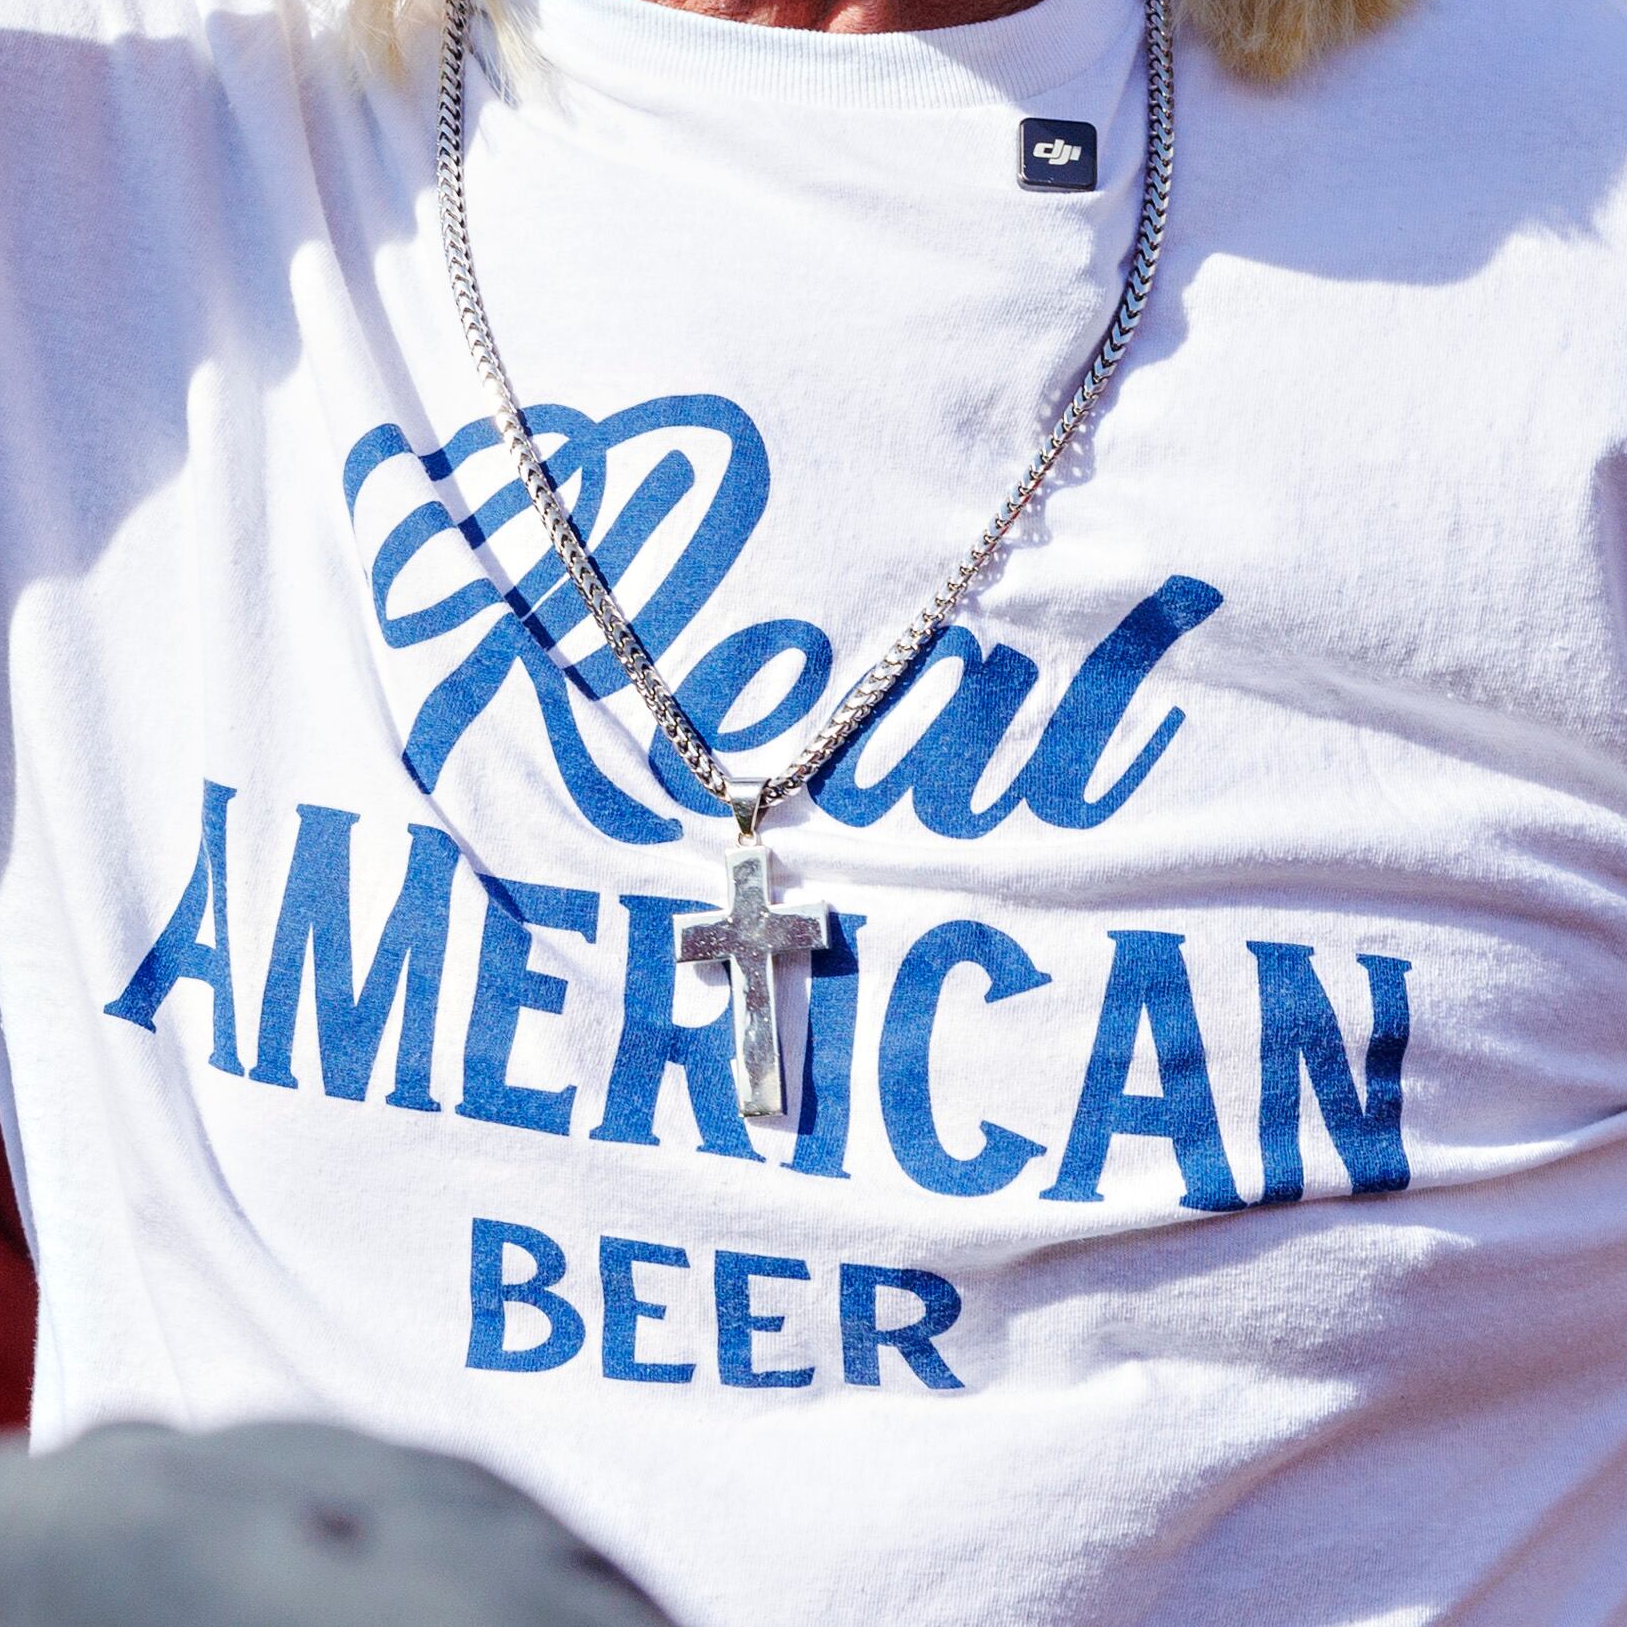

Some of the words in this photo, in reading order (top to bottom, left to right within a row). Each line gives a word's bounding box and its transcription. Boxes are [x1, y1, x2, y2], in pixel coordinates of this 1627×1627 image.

[342, 393, 1225, 847] Real
[103, 778, 1413, 1213] AMERICAN
[464, 1216, 967, 1391] BEER
